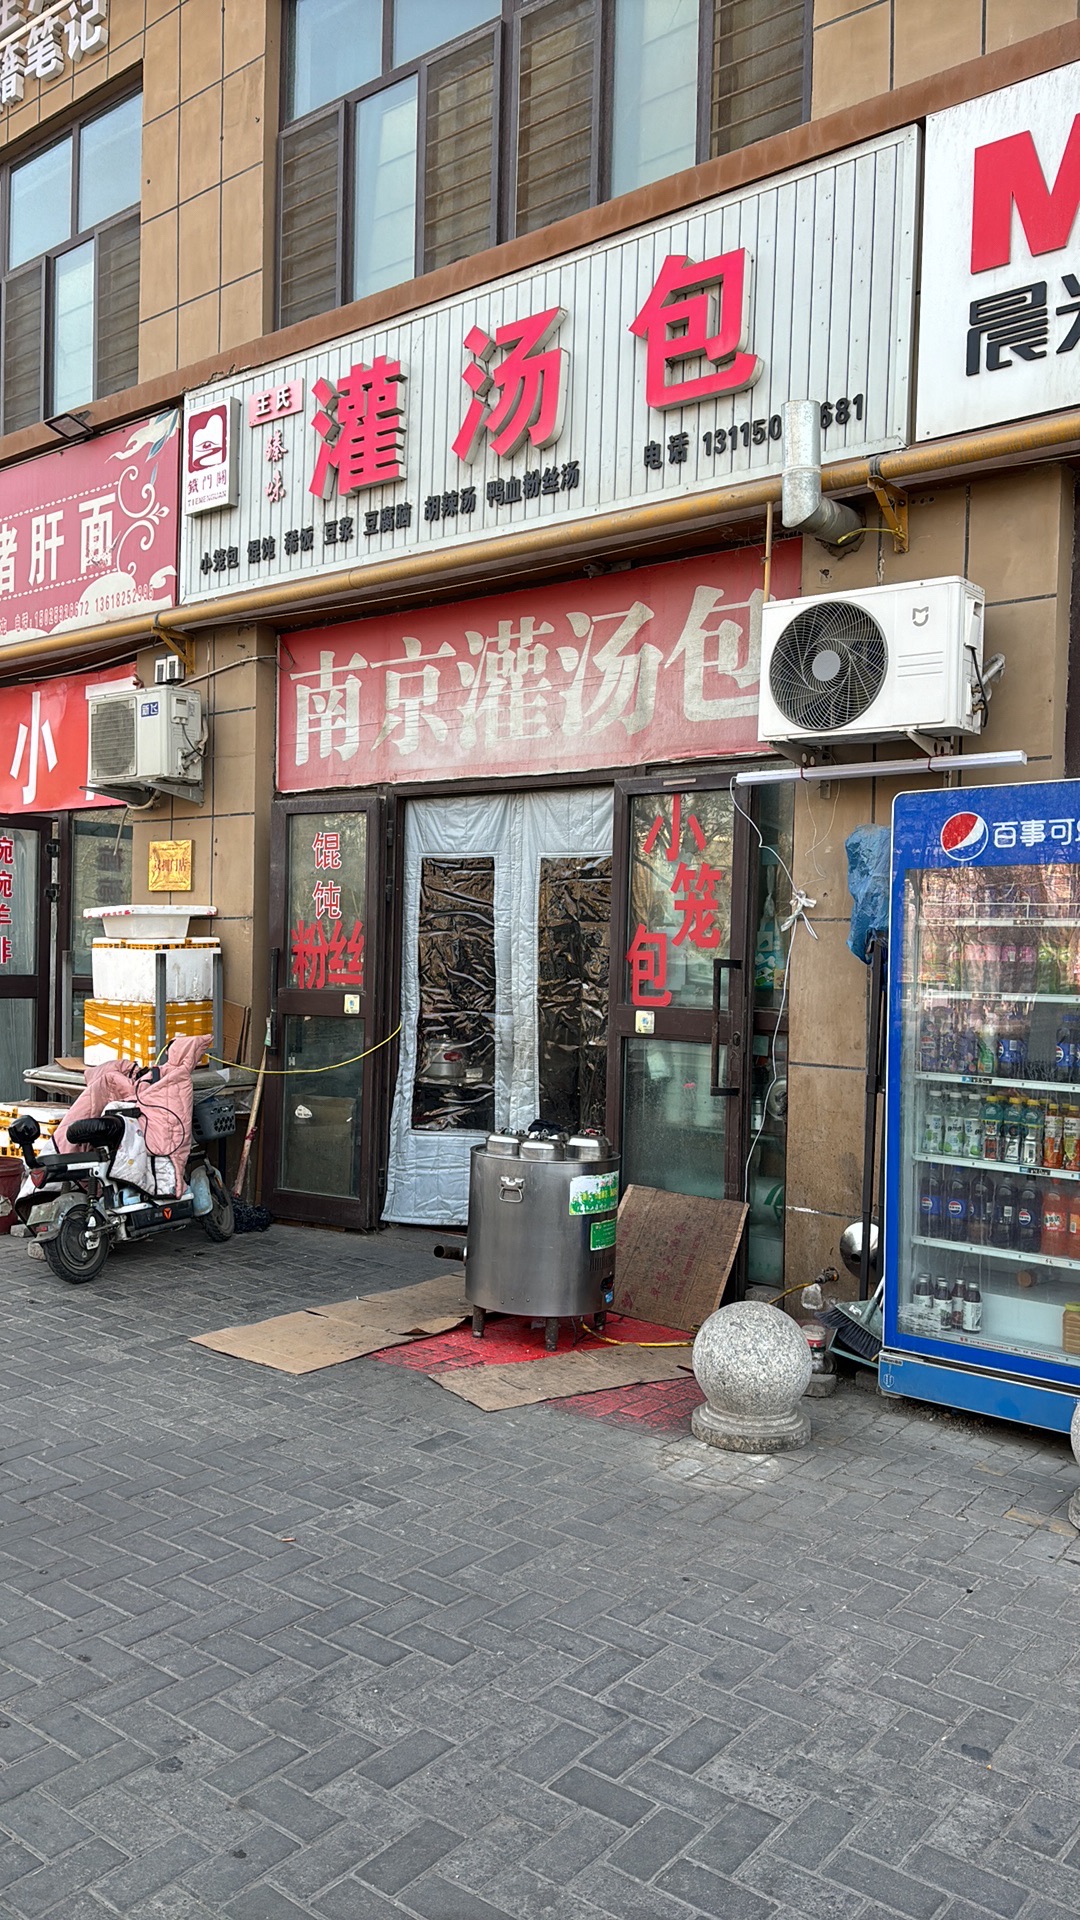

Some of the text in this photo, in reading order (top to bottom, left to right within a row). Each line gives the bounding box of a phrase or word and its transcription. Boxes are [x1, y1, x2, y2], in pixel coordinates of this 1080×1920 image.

[256, 386, 292, 417] 王氏
[309, 247, 763, 500] 灌汤包
[644, 393, 864, 469] 电话 131150681
[200, 461, 580, 575] 小笼包 馄饨 稀饭 豆浆 豆腐脑 胡辣汤 鸭血粉丝汤
[290, 585, 776, 767] 南京灌汤包
[312, 832, 342, 920] 馄饨
[626, 793, 722, 1007] 小笼包
[291, 920, 364, 990] 粉丝
